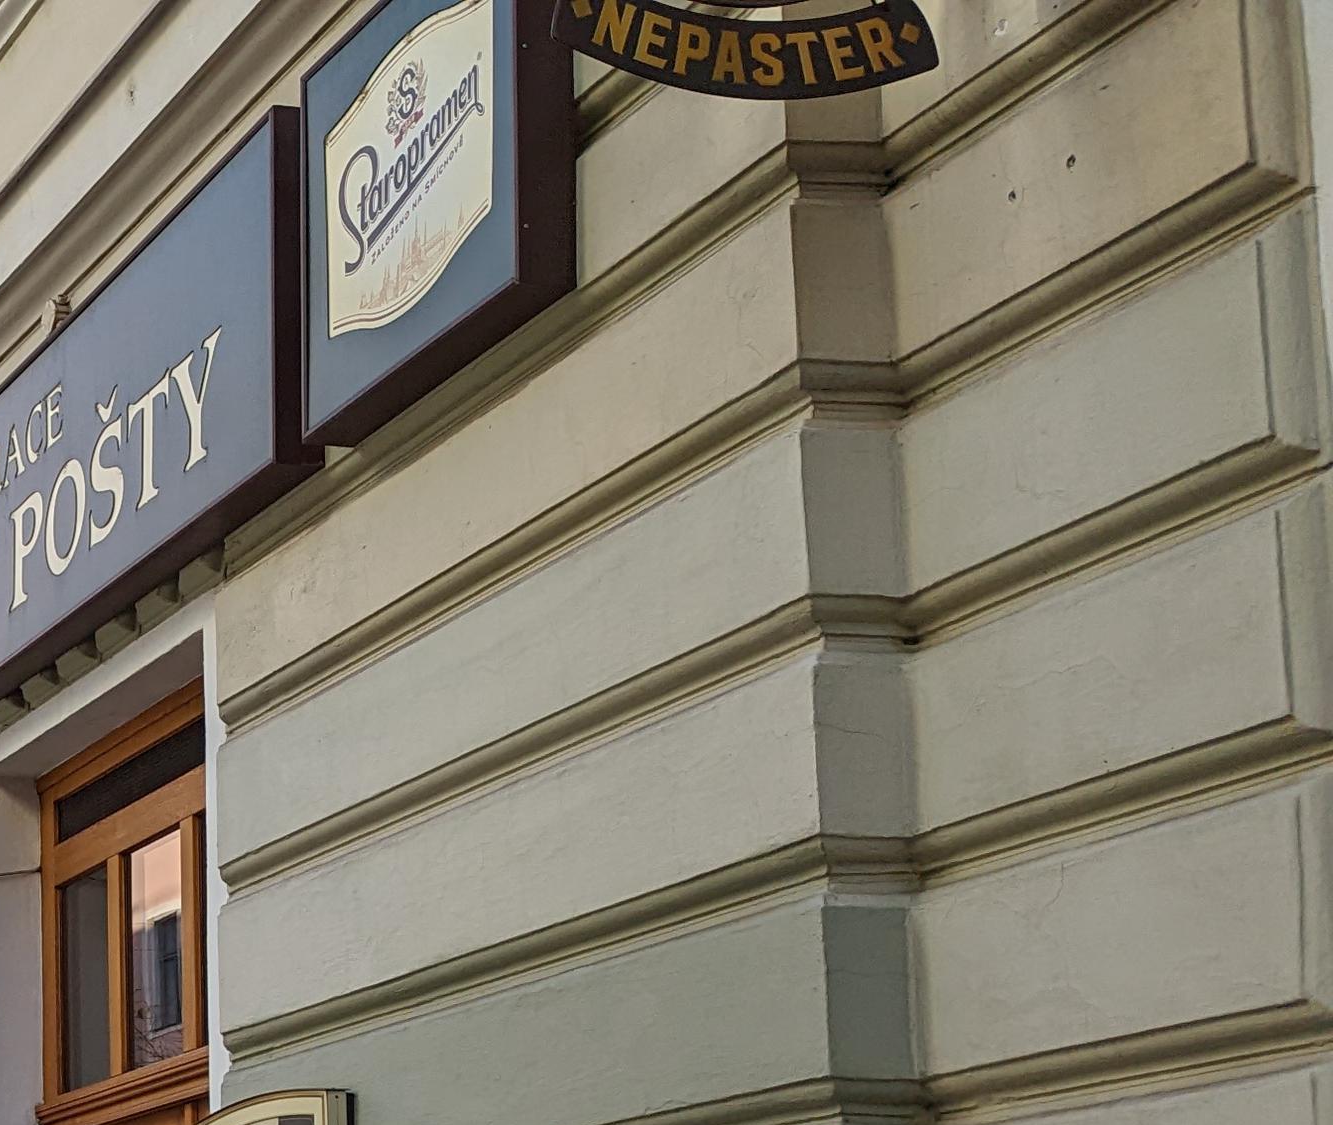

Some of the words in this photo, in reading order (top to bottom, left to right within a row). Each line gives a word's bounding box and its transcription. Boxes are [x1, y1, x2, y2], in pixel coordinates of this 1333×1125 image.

[591, 0, 906, 87] NEPASTER
[338, 63, 486, 275] Staropramen
[370, 208, 410, 266] ZALOŽENO
[411, 193, 425, 212] NA
[8, 325, 223, 613] POŠTY
